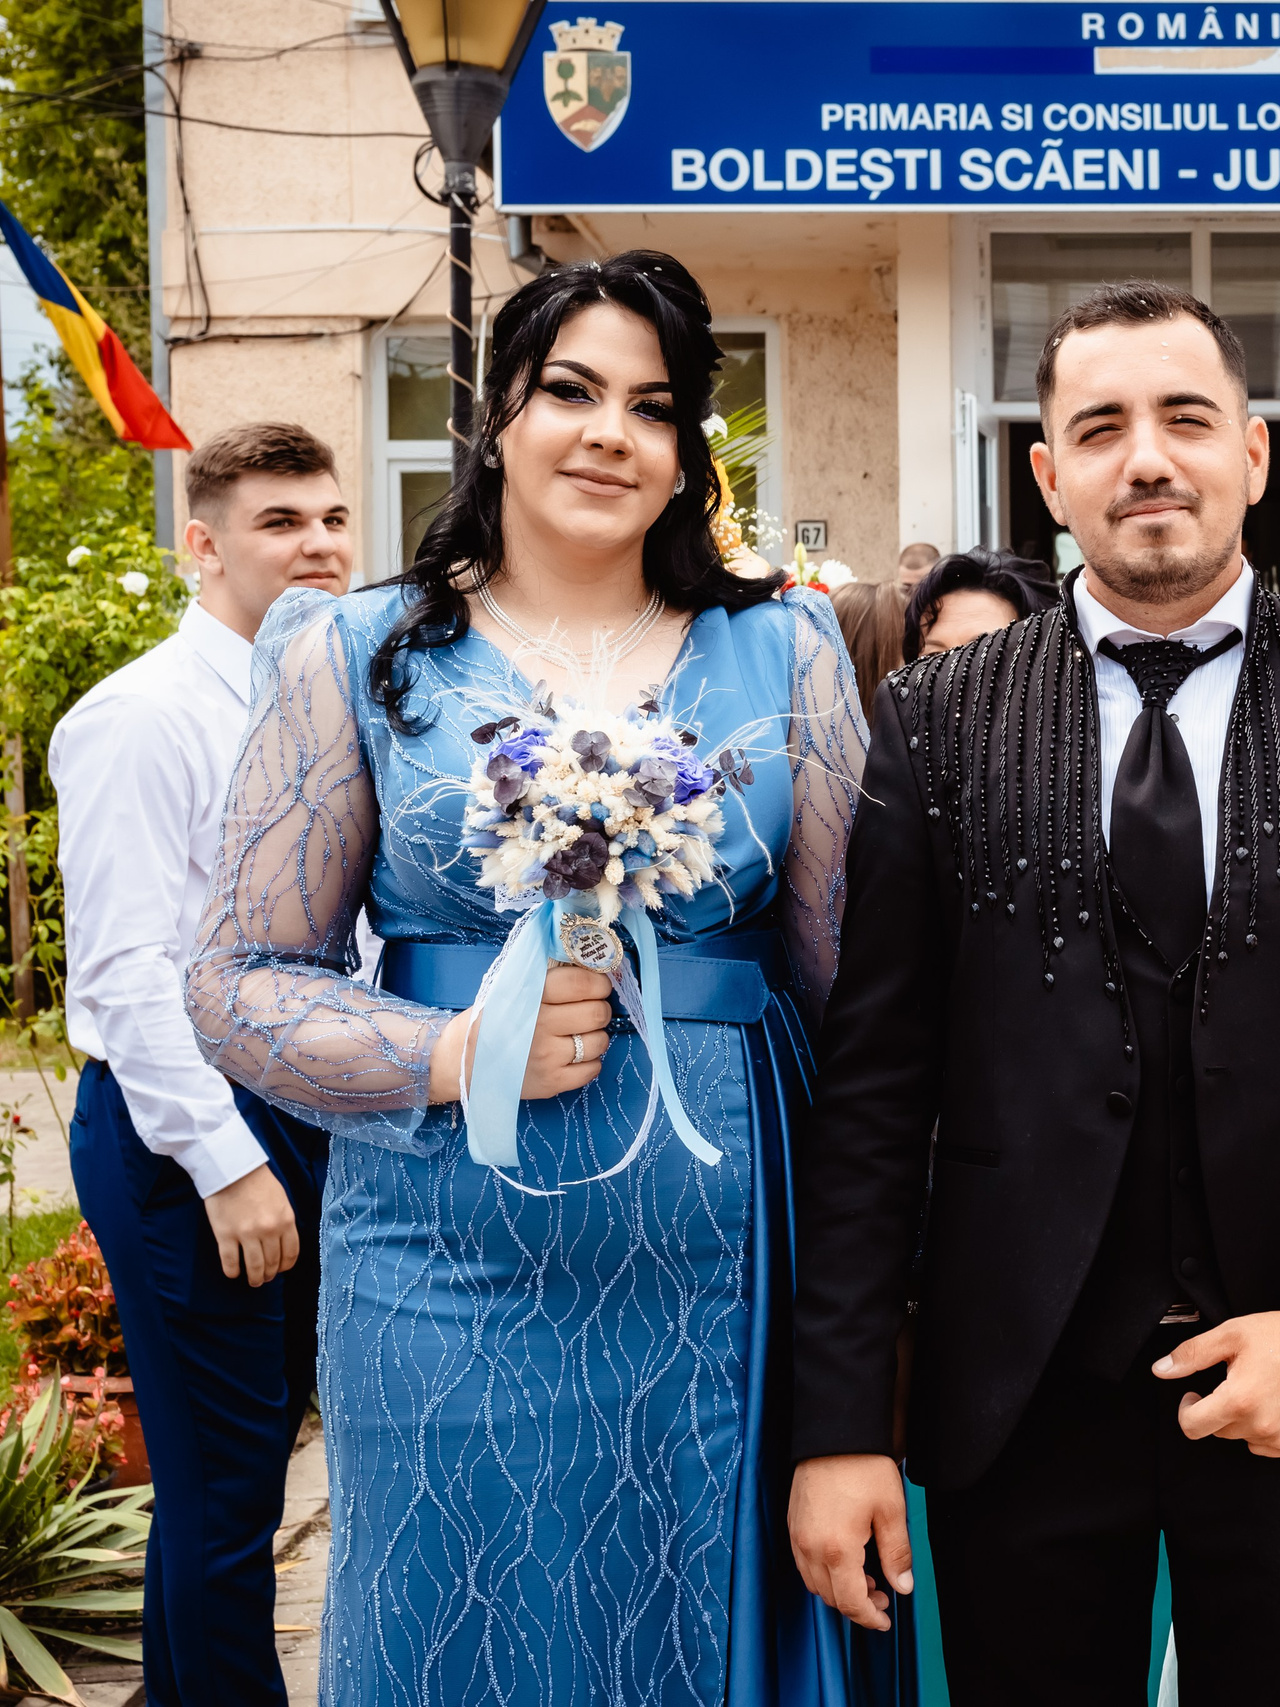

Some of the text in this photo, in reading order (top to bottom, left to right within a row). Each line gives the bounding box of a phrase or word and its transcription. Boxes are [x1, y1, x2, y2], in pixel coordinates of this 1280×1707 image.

[822, 103, 992, 131] PRIMARIA
[1001, 103, 1033, 131] SI
[1043, 103, 1229, 131] CONSILIUL
[801, 527, 821, 545] 67
